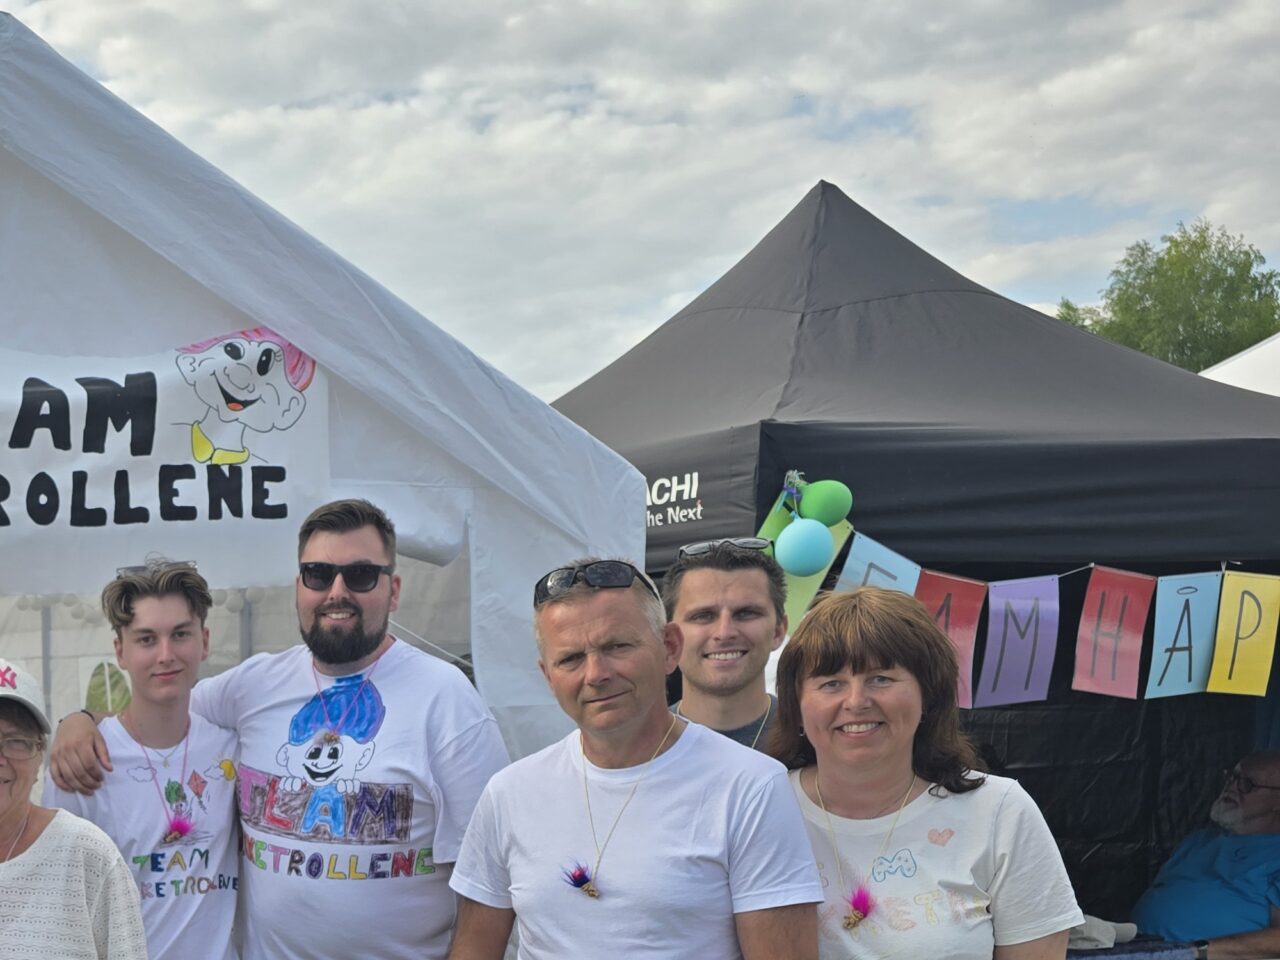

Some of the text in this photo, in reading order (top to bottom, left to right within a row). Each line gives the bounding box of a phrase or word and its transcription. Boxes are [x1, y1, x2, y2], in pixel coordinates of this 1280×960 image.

[667, 500, 704, 524] Next
[1090, 586, 1263, 687] HÅP
[132, 848, 209, 872] TEAM
